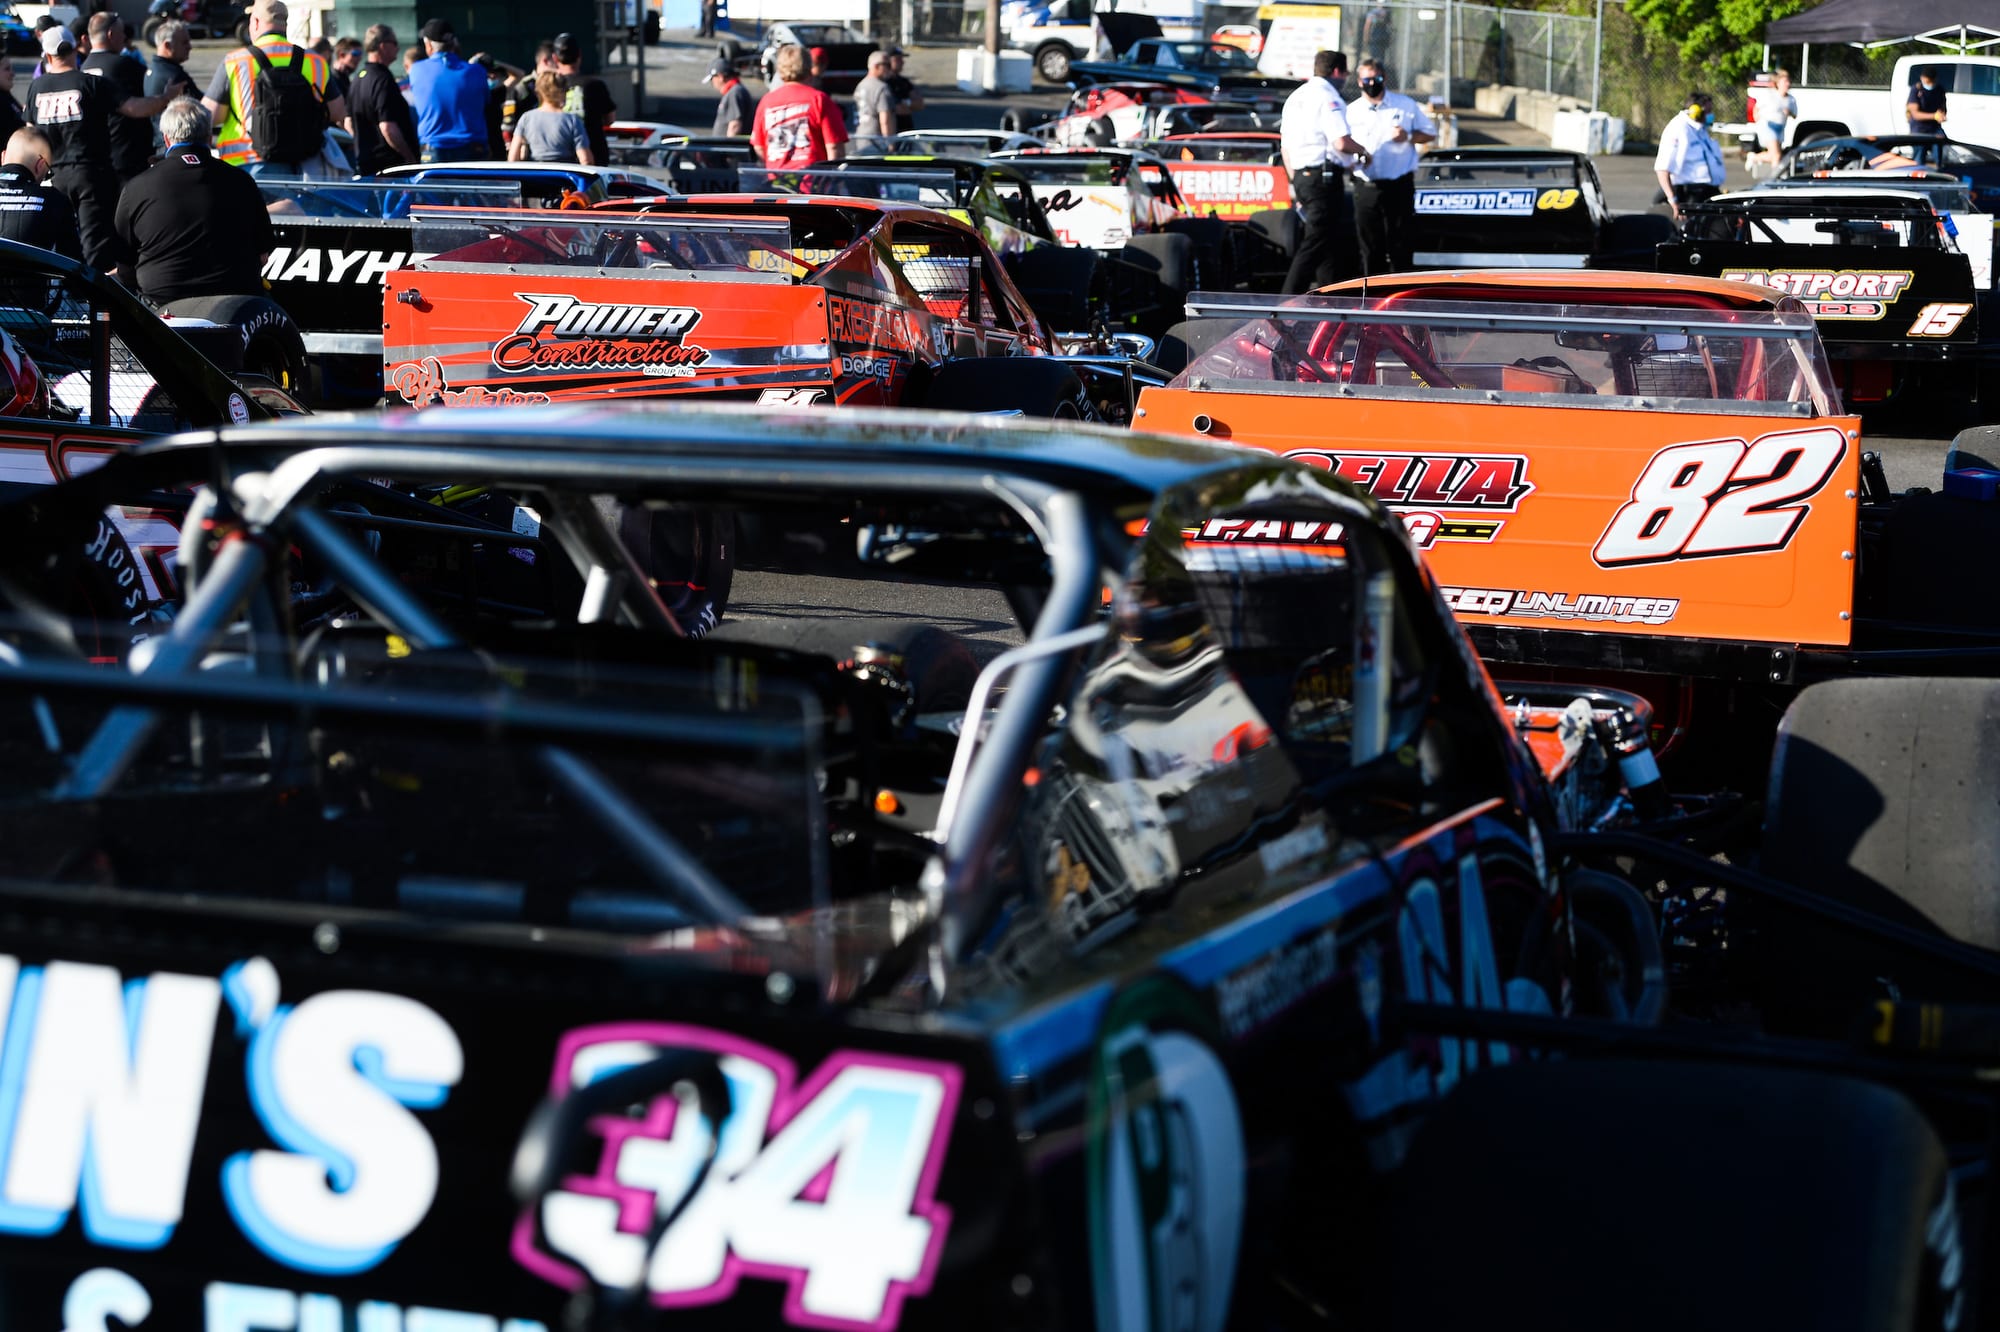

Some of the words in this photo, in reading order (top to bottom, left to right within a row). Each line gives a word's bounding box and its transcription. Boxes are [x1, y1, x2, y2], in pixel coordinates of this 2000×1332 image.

[1536, 188, 1580, 210] 03
[260, 247, 438, 285] MAYH
[514, 293, 702, 342] POWER
[1906, 303, 1973, 337] 15
[493, 333, 710, 370] Construction
[842, 354, 891, 378] DODGE
[644, 367, 677, 376] GROUP
[1592, 427, 1847, 568] 82
[1202, 512, 1439, 545] PAVIG
[1440, 587, 1514, 613] EED
[1513, 591, 1680, 618] UNLIMITED
[0, 955, 464, 1275] N'S
[512, 1020, 962, 1330] 34
